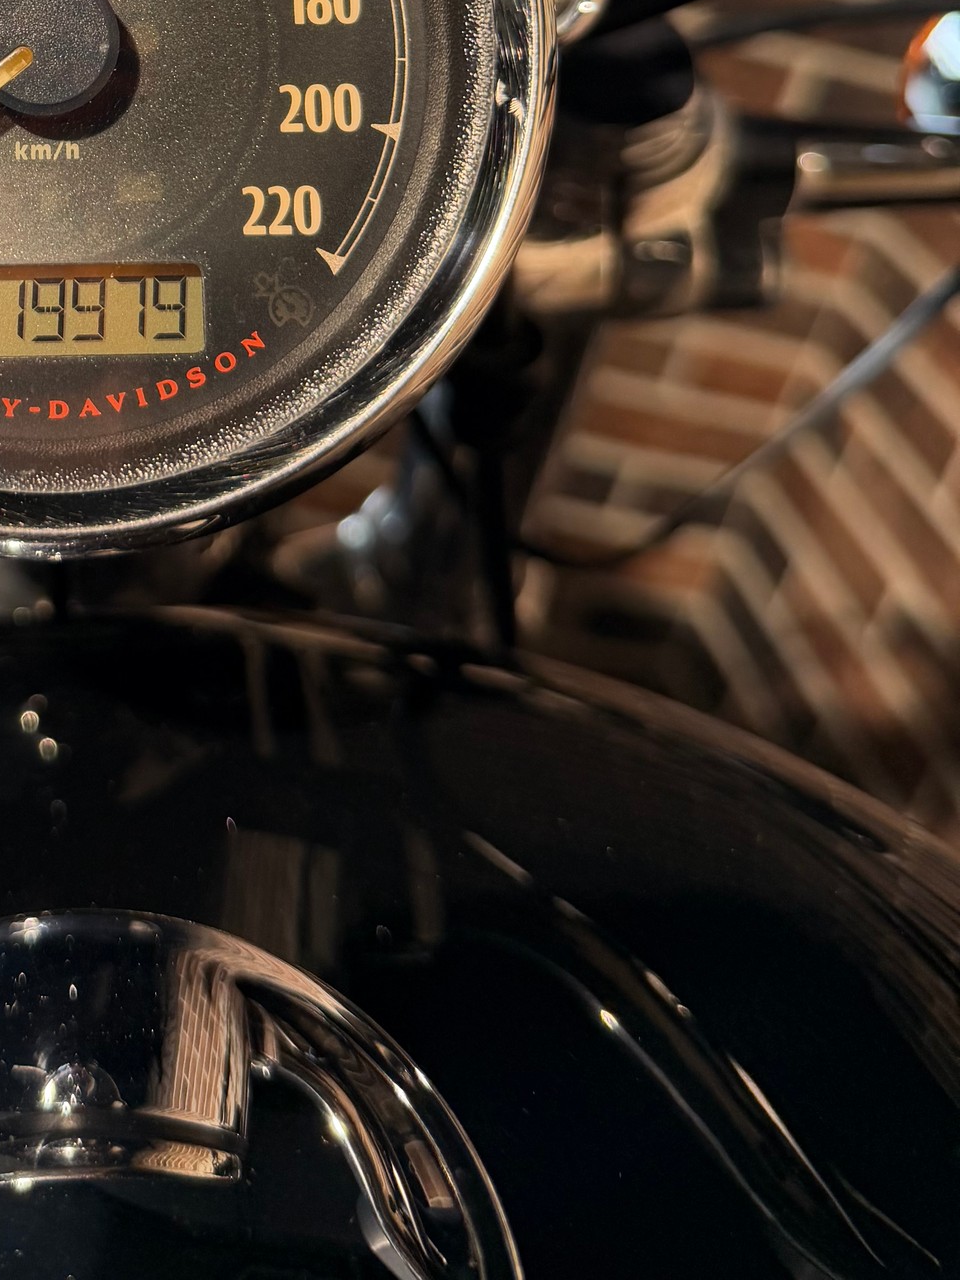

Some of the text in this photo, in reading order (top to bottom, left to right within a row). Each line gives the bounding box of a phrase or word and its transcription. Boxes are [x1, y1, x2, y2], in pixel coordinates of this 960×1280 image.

[279, 84, 362, 133] 200
[14, 141, 80, 160] km/h
[242, 185, 322, 235] 220
